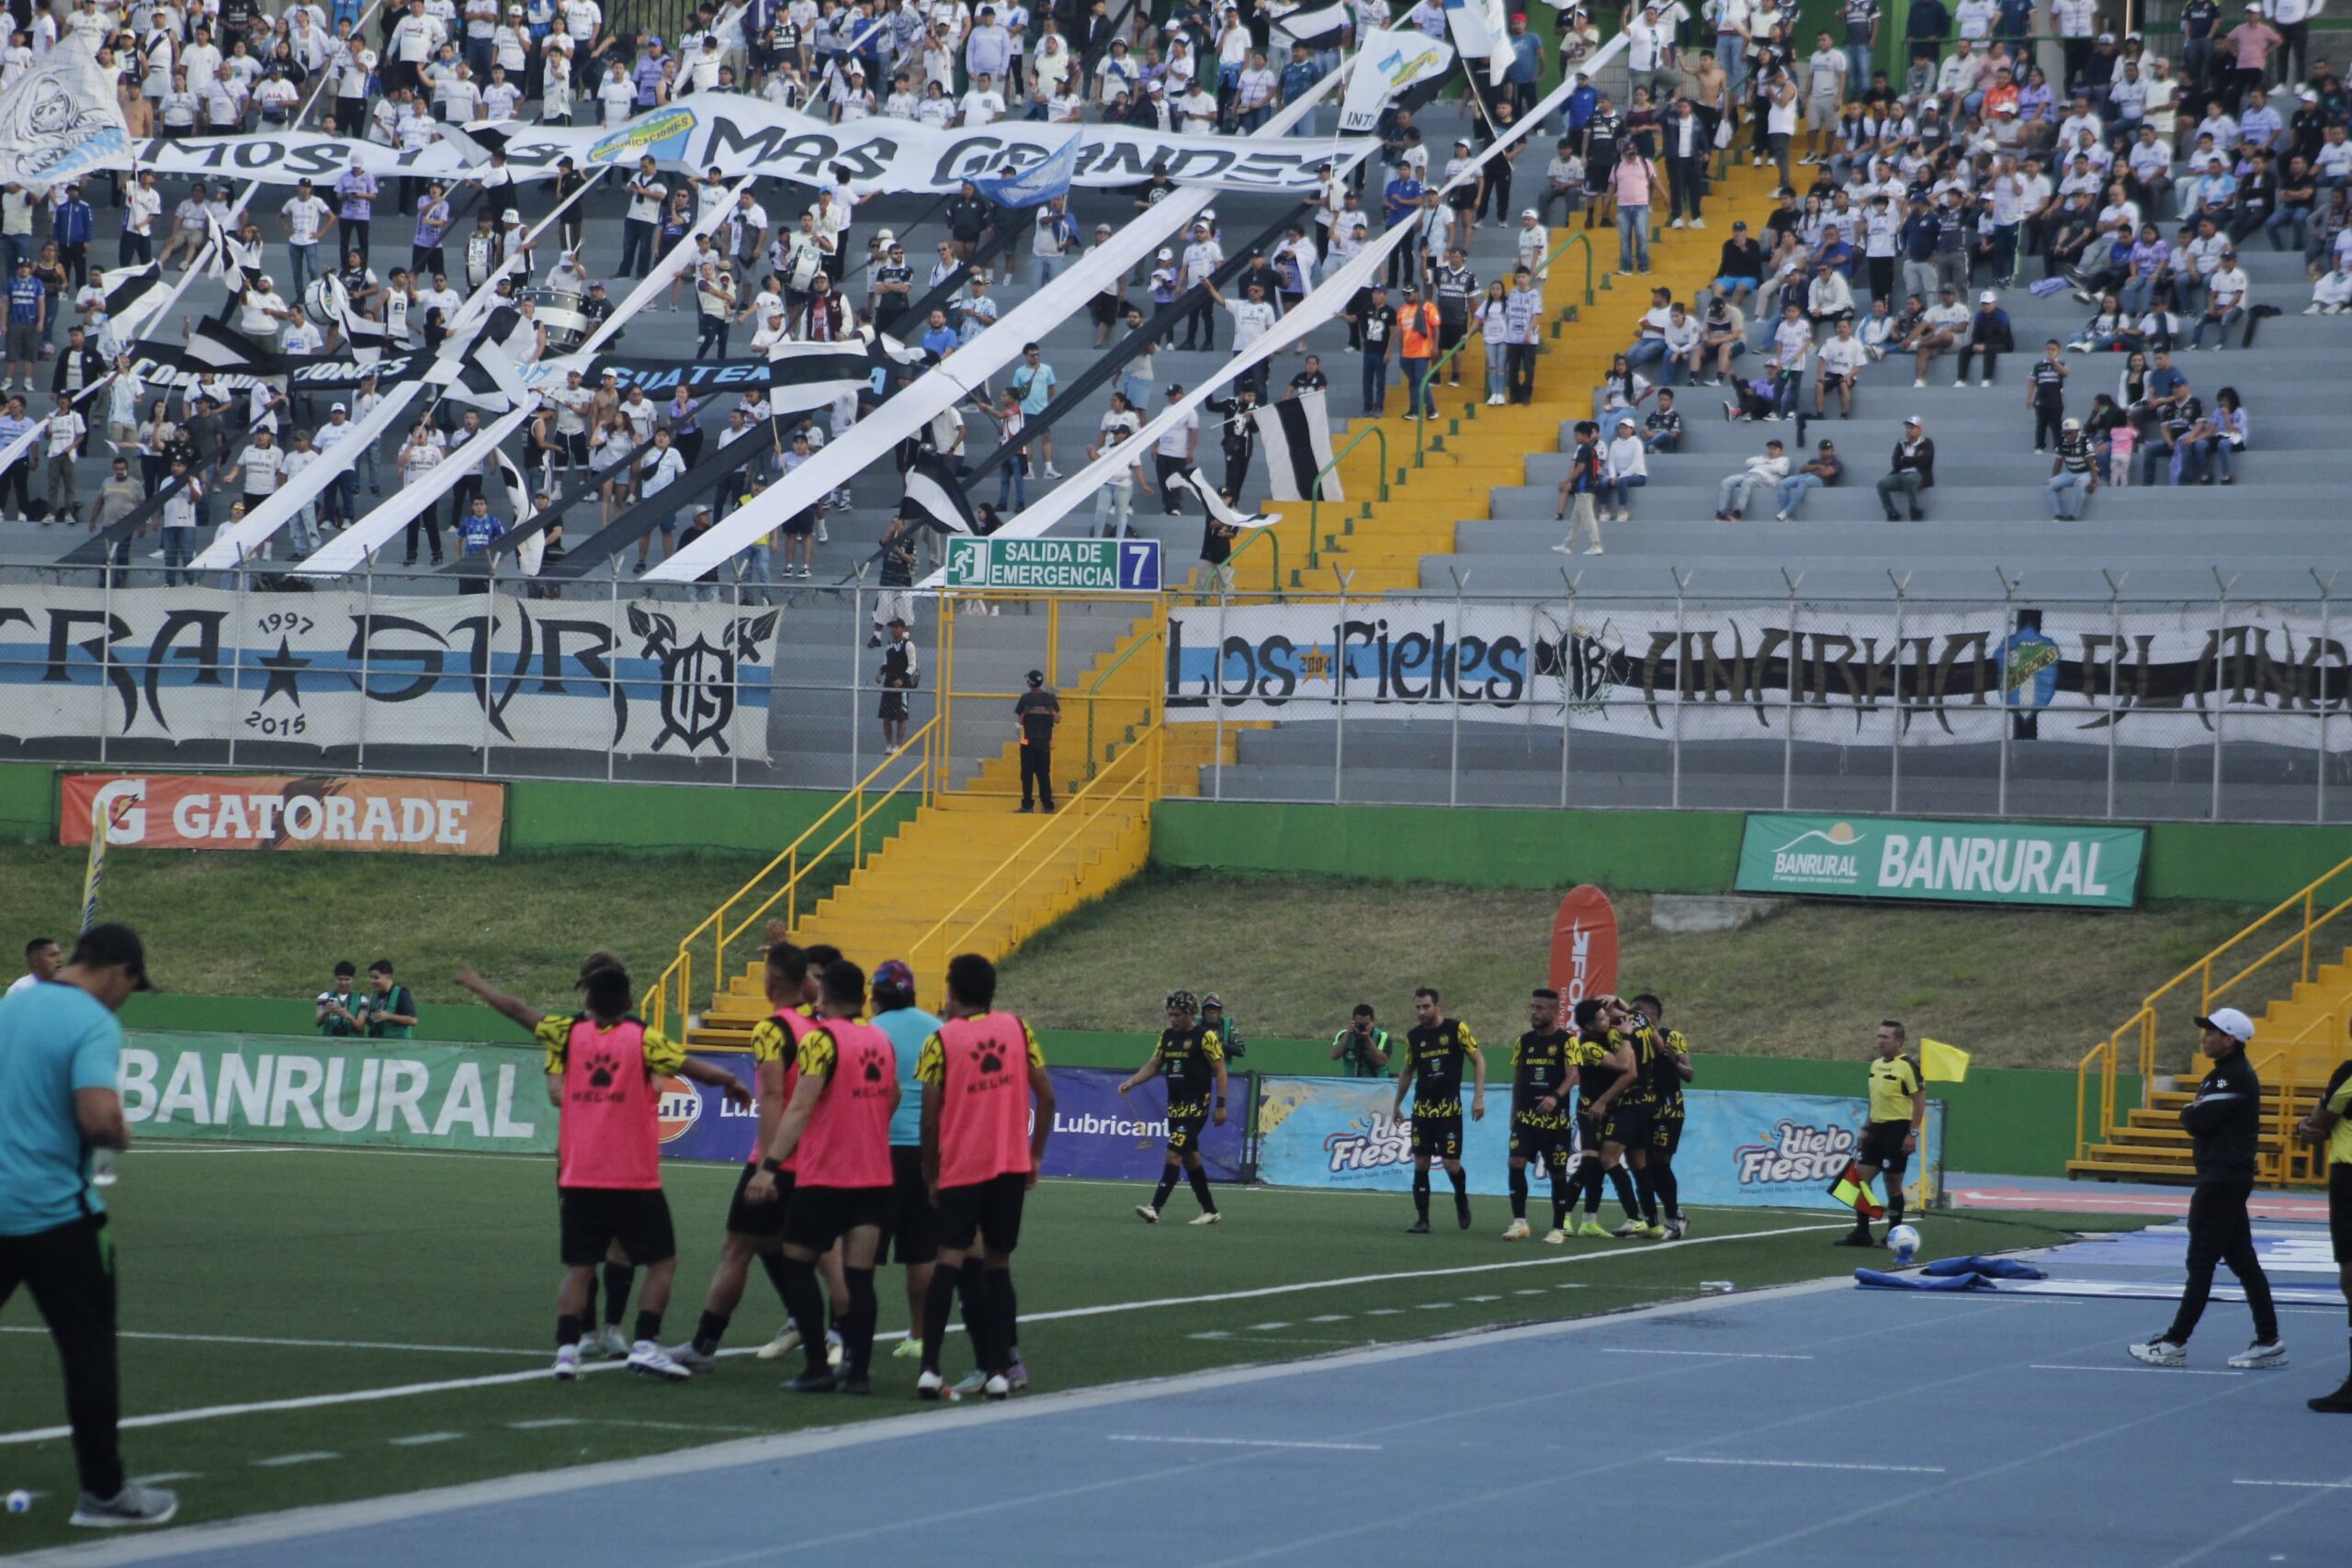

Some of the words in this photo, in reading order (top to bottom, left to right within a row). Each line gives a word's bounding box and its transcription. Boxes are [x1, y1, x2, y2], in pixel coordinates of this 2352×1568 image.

[701, 116, 898, 179] MAS
[1005, 542, 1073, 562] SALIDA
[1077, 544, 1102, 563] DE
[991, 565, 1114, 586] EMERGENCIA
[1129, 546, 1149, 586] 7
[257, 612, 314, 636] 1997
[244, 710, 306, 736] 2015
[172, 793, 469, 845] GATORADE
[1774, 853, 1858, 876] BANRURAL
[1877, 834, 2108, 896] BANRURAL
[119, 1048, 535, 1139] BANRURAL
[659, 1099, 696, 1117] ulf
[1053, 1112, 1170, 1137] Lubricant
[1169, 1132, 1186, 1146] 23
[1777, 1121, 1854, 1160] Hielo
